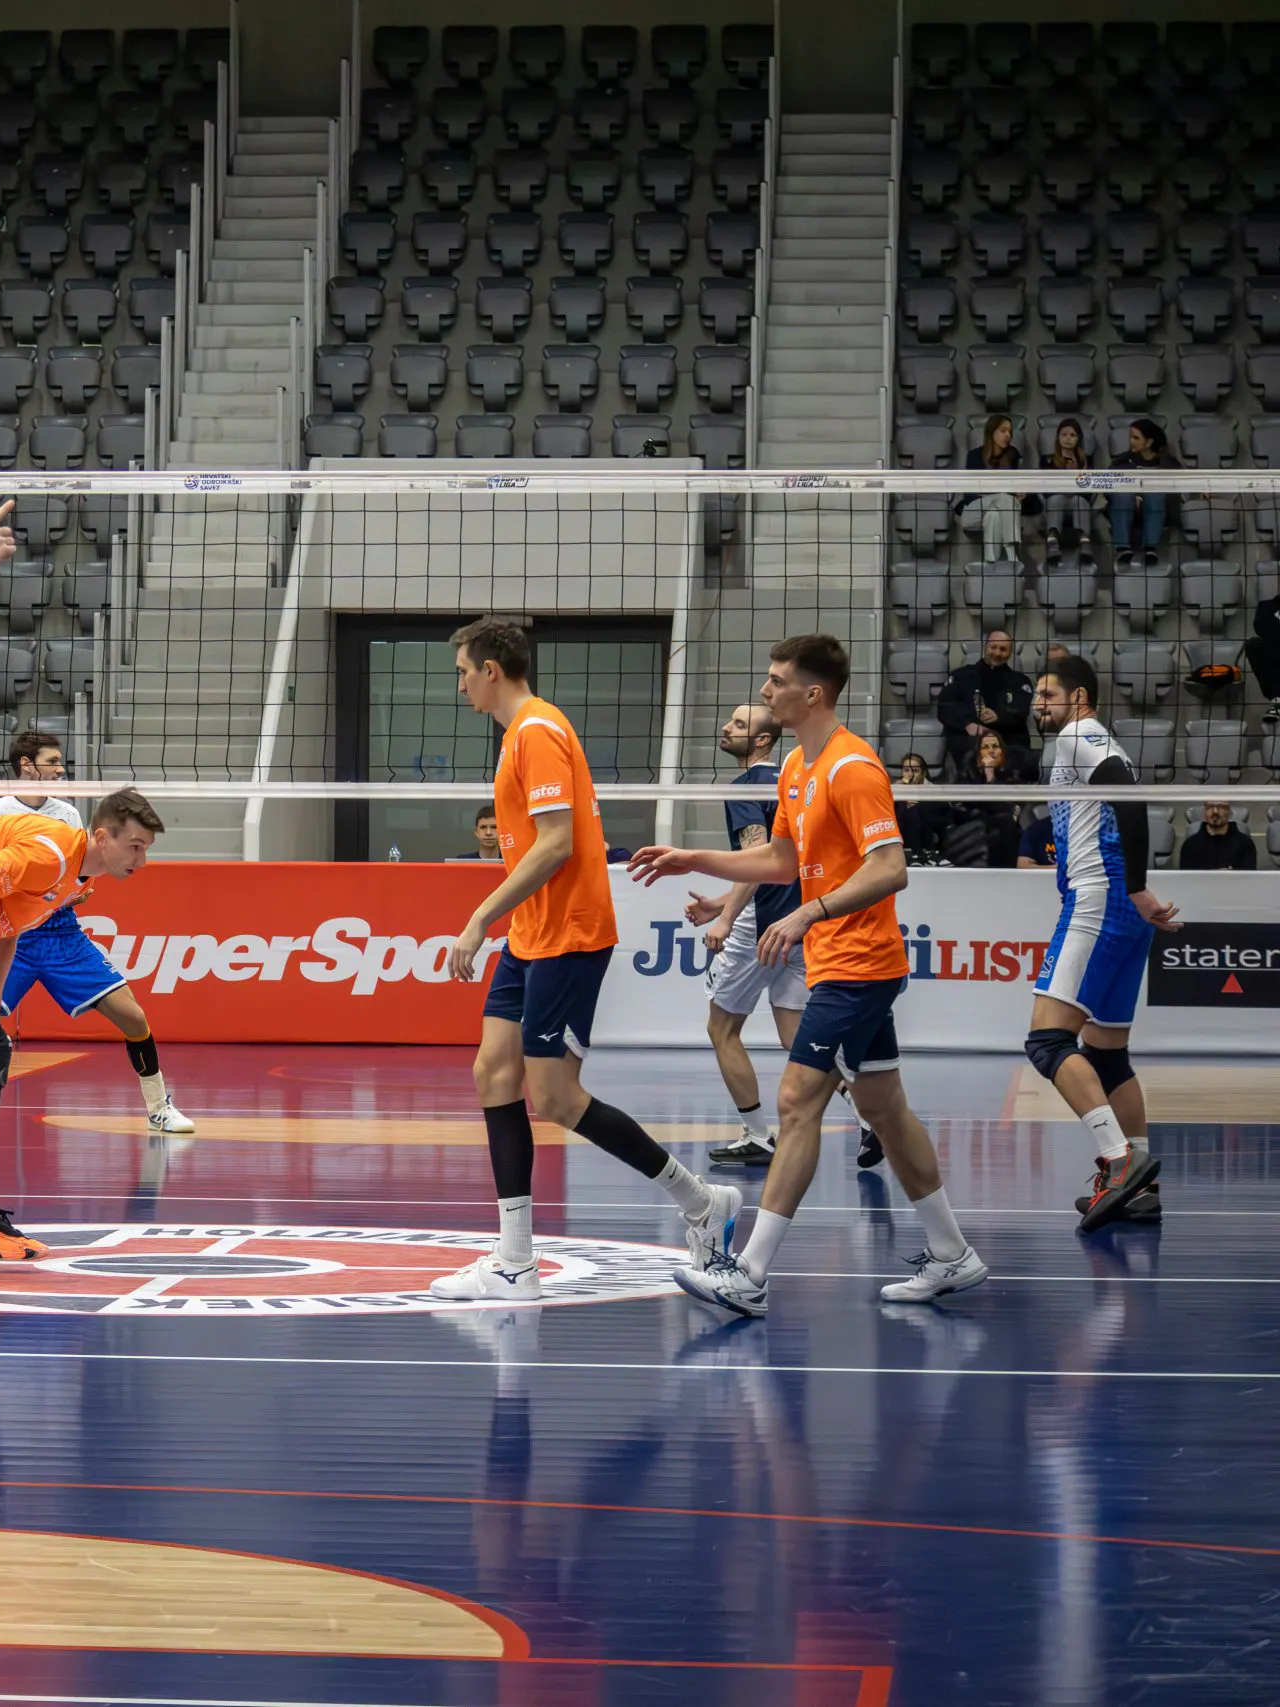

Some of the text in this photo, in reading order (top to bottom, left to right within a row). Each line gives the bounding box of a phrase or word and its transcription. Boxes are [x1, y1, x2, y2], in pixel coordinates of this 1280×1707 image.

[529, 785, 562, 802] nstos
[75, 915, 509, 996] SuperSpor
[1162, 944, 1280, 968] stater
[141, 1227, 501, 1245] HOLDING
[124, 1294, 475, 1309] OSIJEK
